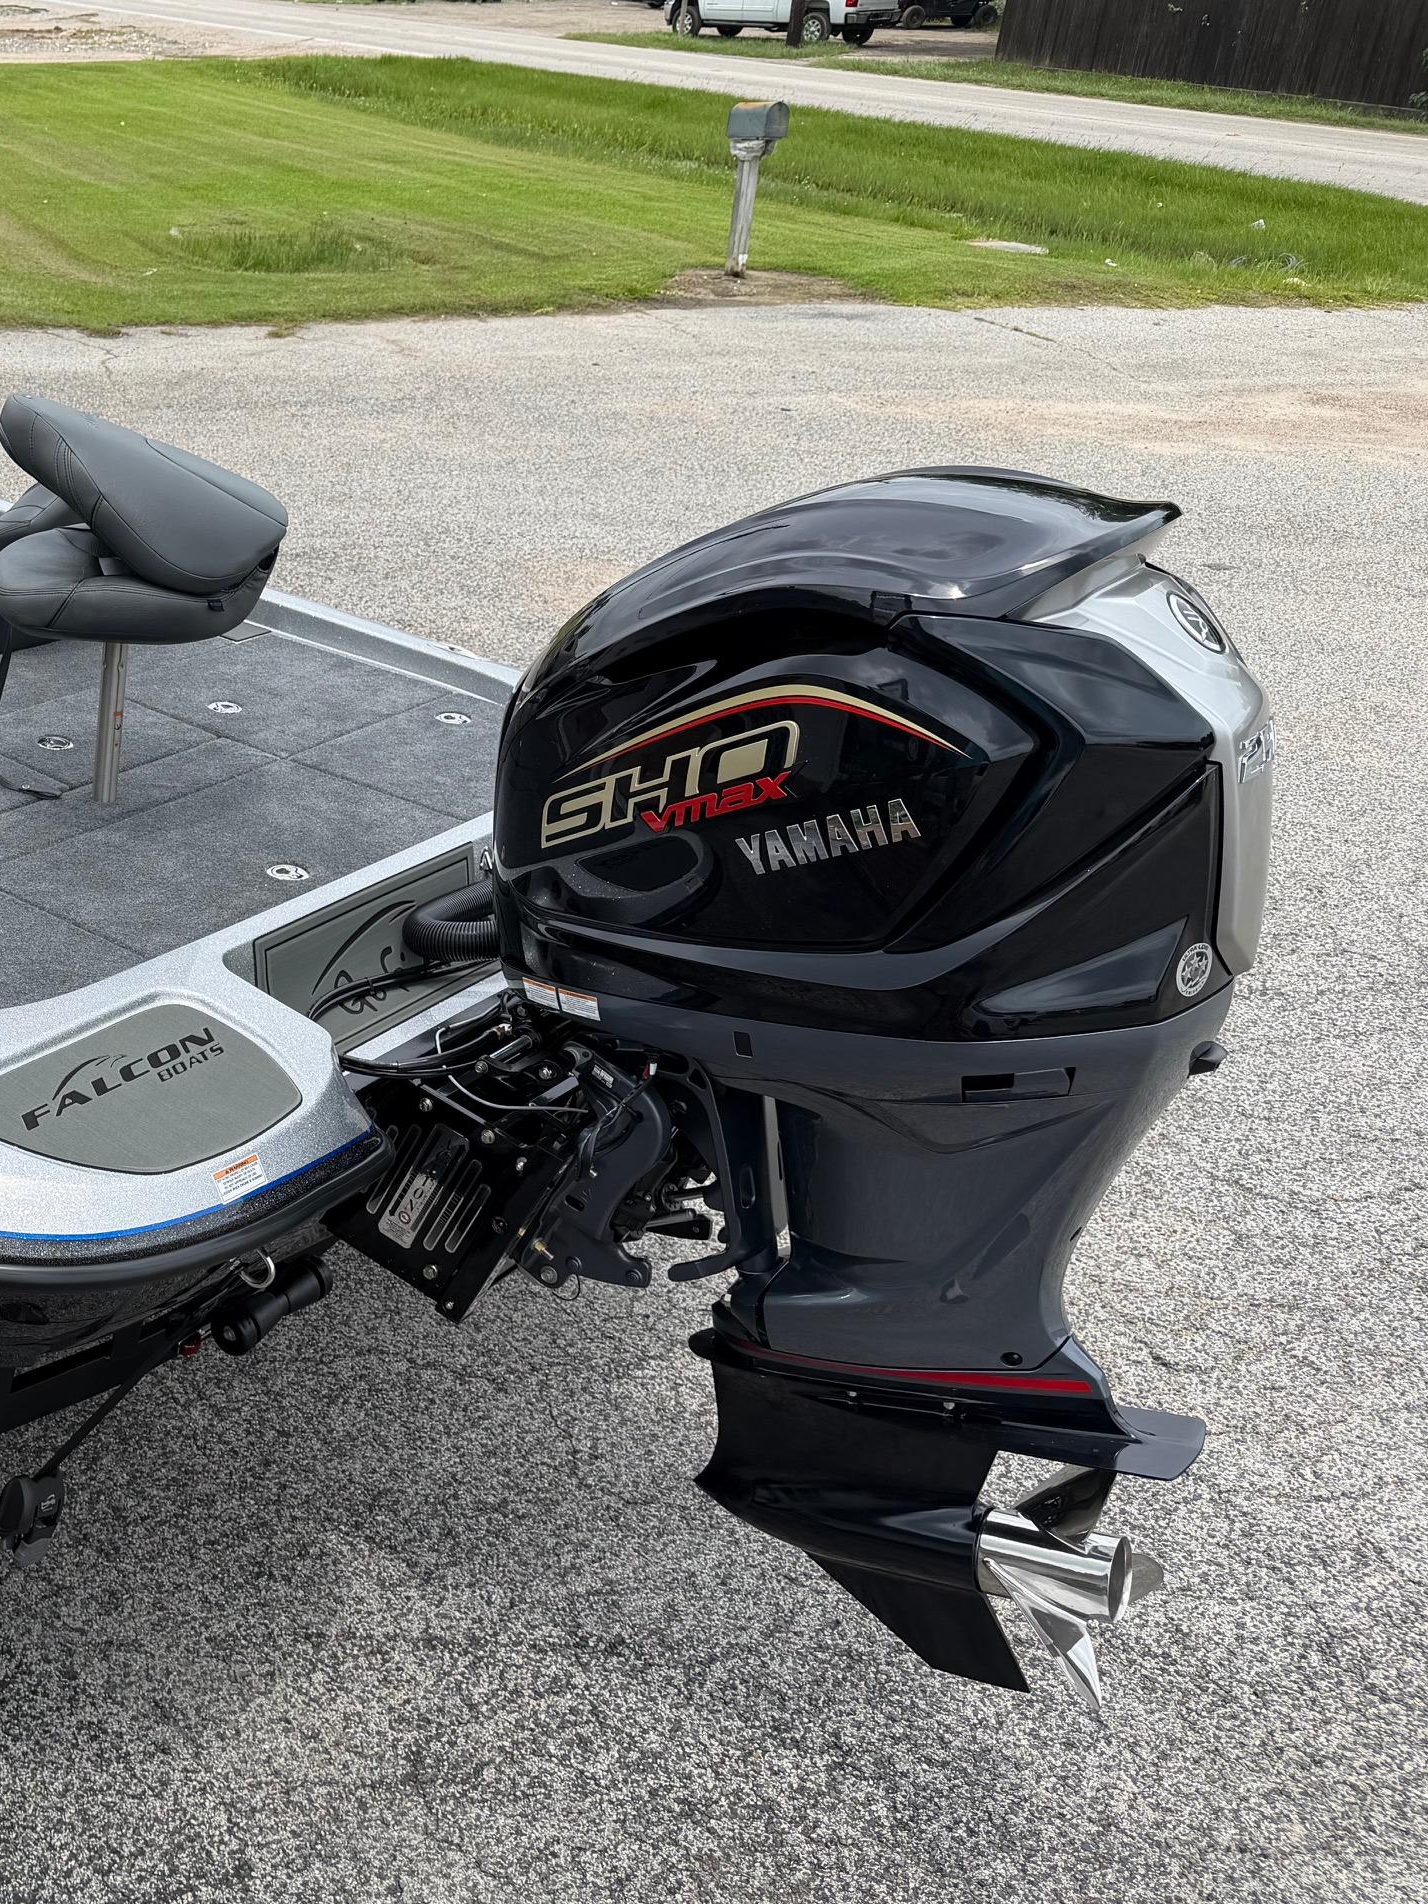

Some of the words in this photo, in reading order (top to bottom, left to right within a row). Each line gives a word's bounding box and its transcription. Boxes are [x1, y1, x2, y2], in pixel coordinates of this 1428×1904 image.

[541, 720, 801, 849] SHO
[735, 798, 922, 876] YAMAHA
[21, 1027, 215, 1131] FALCON
[156, 1043, 225, 1083] BOATS
